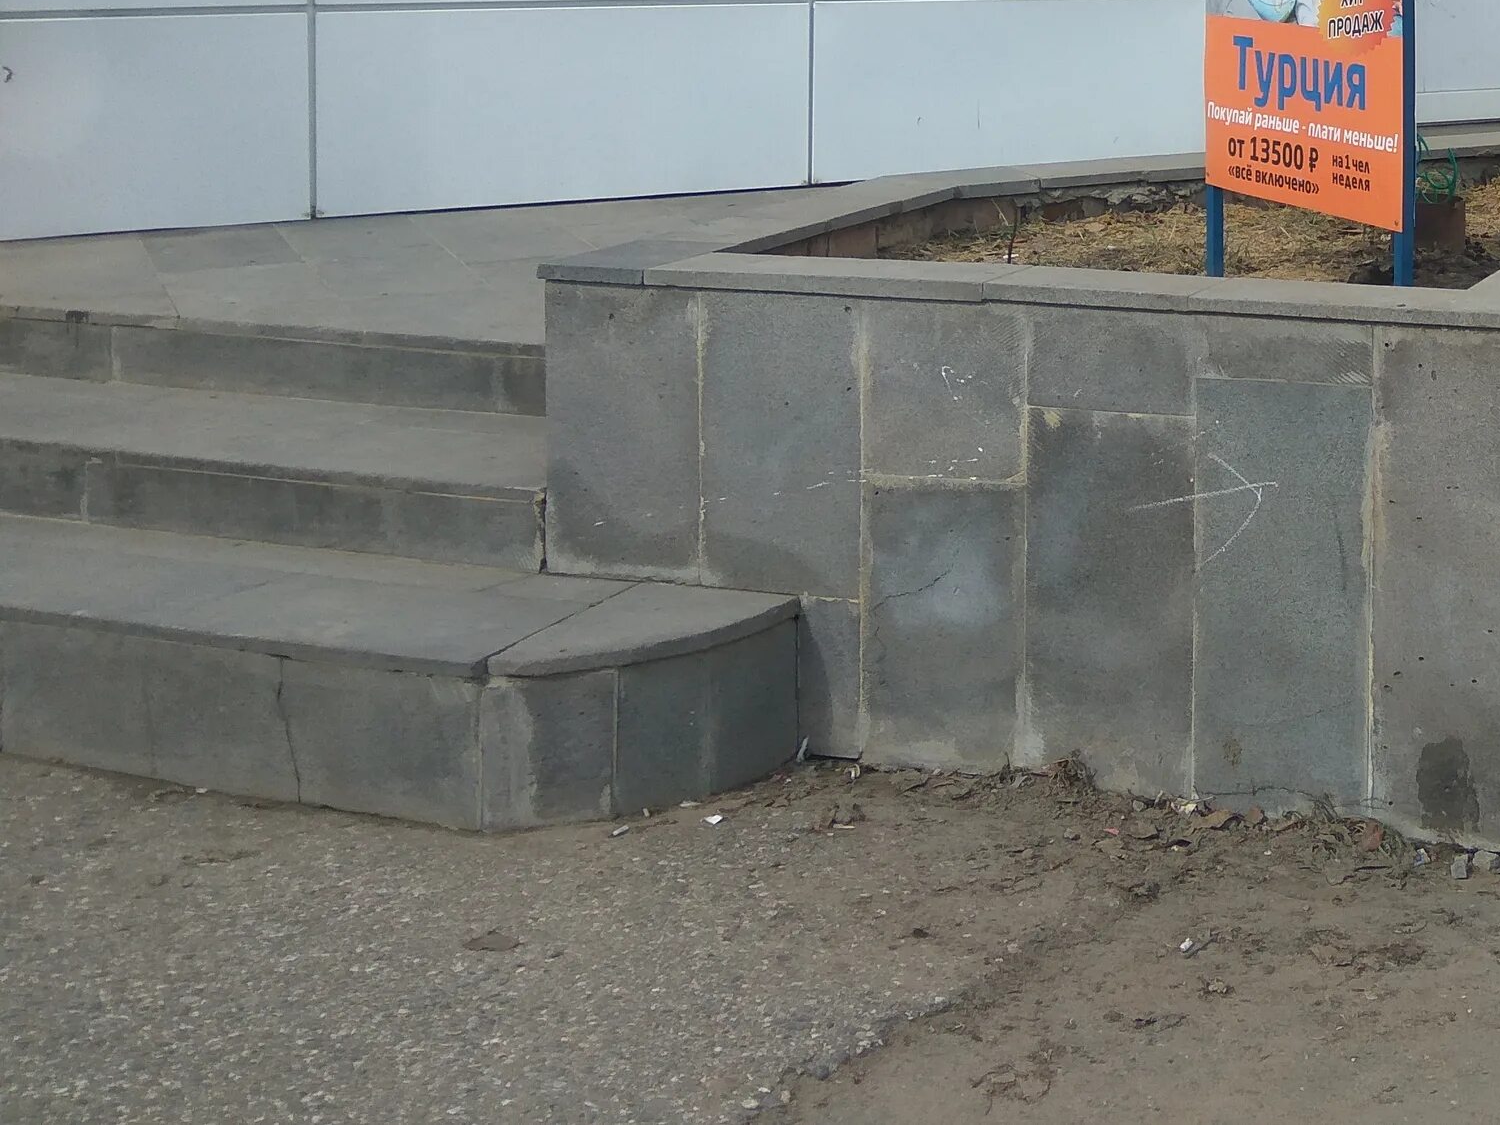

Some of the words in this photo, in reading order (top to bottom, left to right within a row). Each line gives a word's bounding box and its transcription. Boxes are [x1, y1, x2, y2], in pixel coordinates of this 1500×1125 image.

[1328, 10, 1385, 39] ПРОДАЖ
[1233, 35, 1367, 112] Турция
[1207, 101, 1253, 125] Покупай
[1254, 112, 1300, 134] раньше
[1308, 123, 1341, 143] плати
[1343, 131, 1399, 153] меньше!
[1228, 137, 1245, 158] от
[1250, 136, 1304, 171] 13500
[1351, 158, 1370, 174] чел
[1255, 170, 1319, 195] включено»
[1332, 173, 1370, 192] неделя
